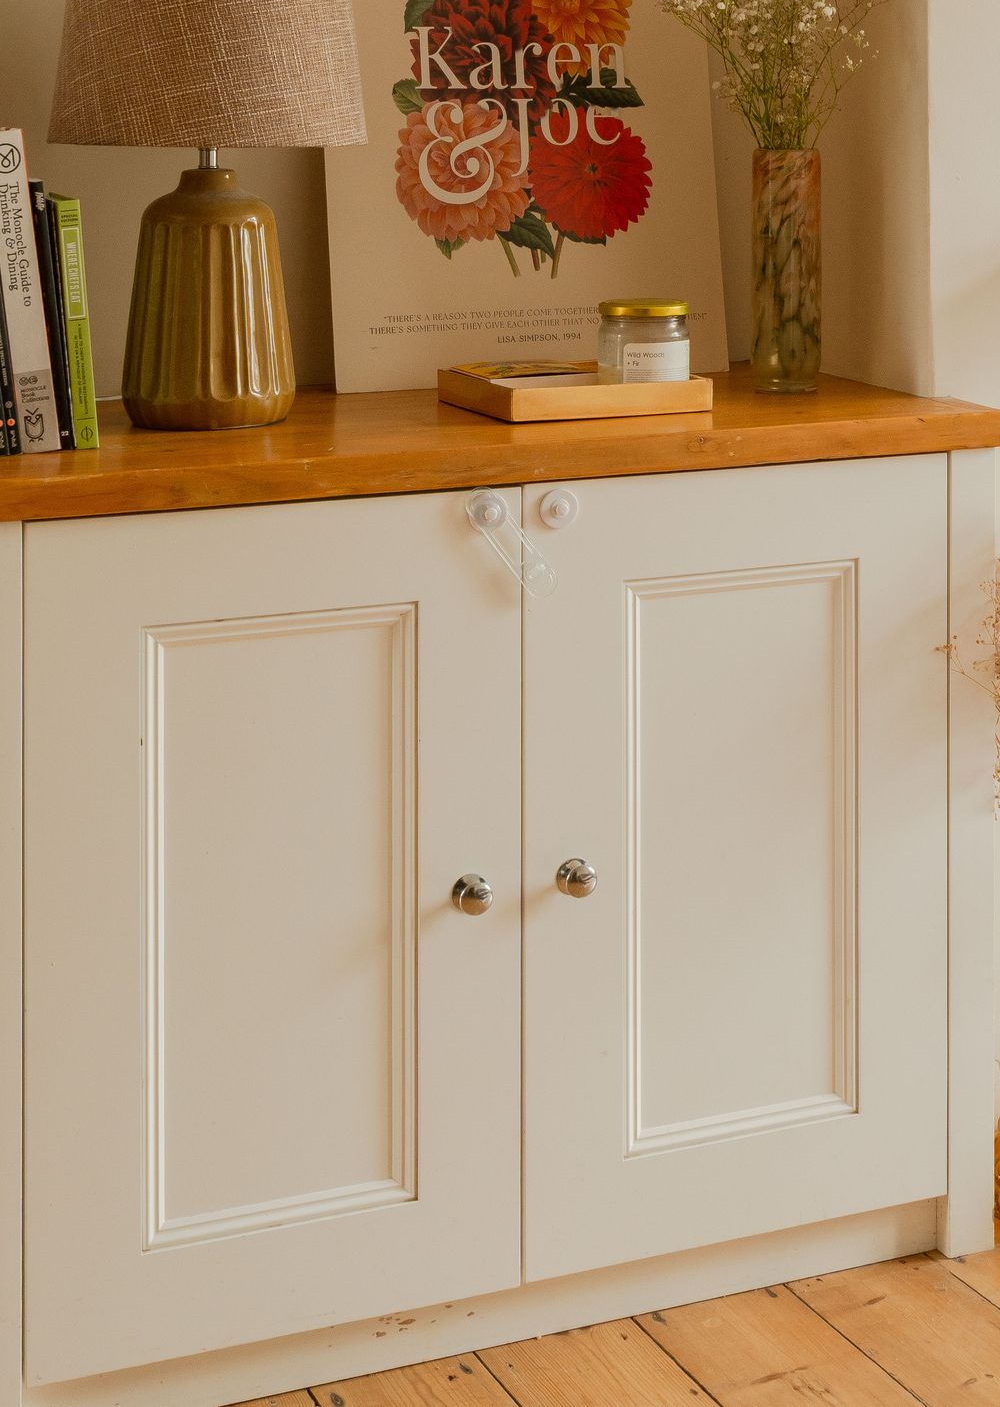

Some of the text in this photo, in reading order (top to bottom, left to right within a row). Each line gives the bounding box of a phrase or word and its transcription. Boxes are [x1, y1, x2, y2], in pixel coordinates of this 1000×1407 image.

[412, 26, 632, 91] Karen
[419, 98, 621, 204] & Joe
[0, 183, 20, 291] Drinking & Dining
[9, 182, 32, 307] The Monocle Guide to
[66, 243, 81, 304] WHERE CHEFS EAT
[369, 326, 404, 335] THERE'S
[406, 323, 458, 333] SOMETHING
[460, 322, 481, 330] THEY
[484, 321, 505, 329] GIVE
[508, 320, 530, 328] EACH
[532, 318, 560, 327] OTHER
[562, 317, 584, 326] THAT
[432, 312, 467, 321] REASON
[470, 310, 491, 319] TWO
[493, 309, 524, 318] PEOPLE
[526, 308, 552, 317] COME
[555, 306, 599, 316] TOGETHER
[497, 332, 581, 344] LISA SIMPSON, 1994
